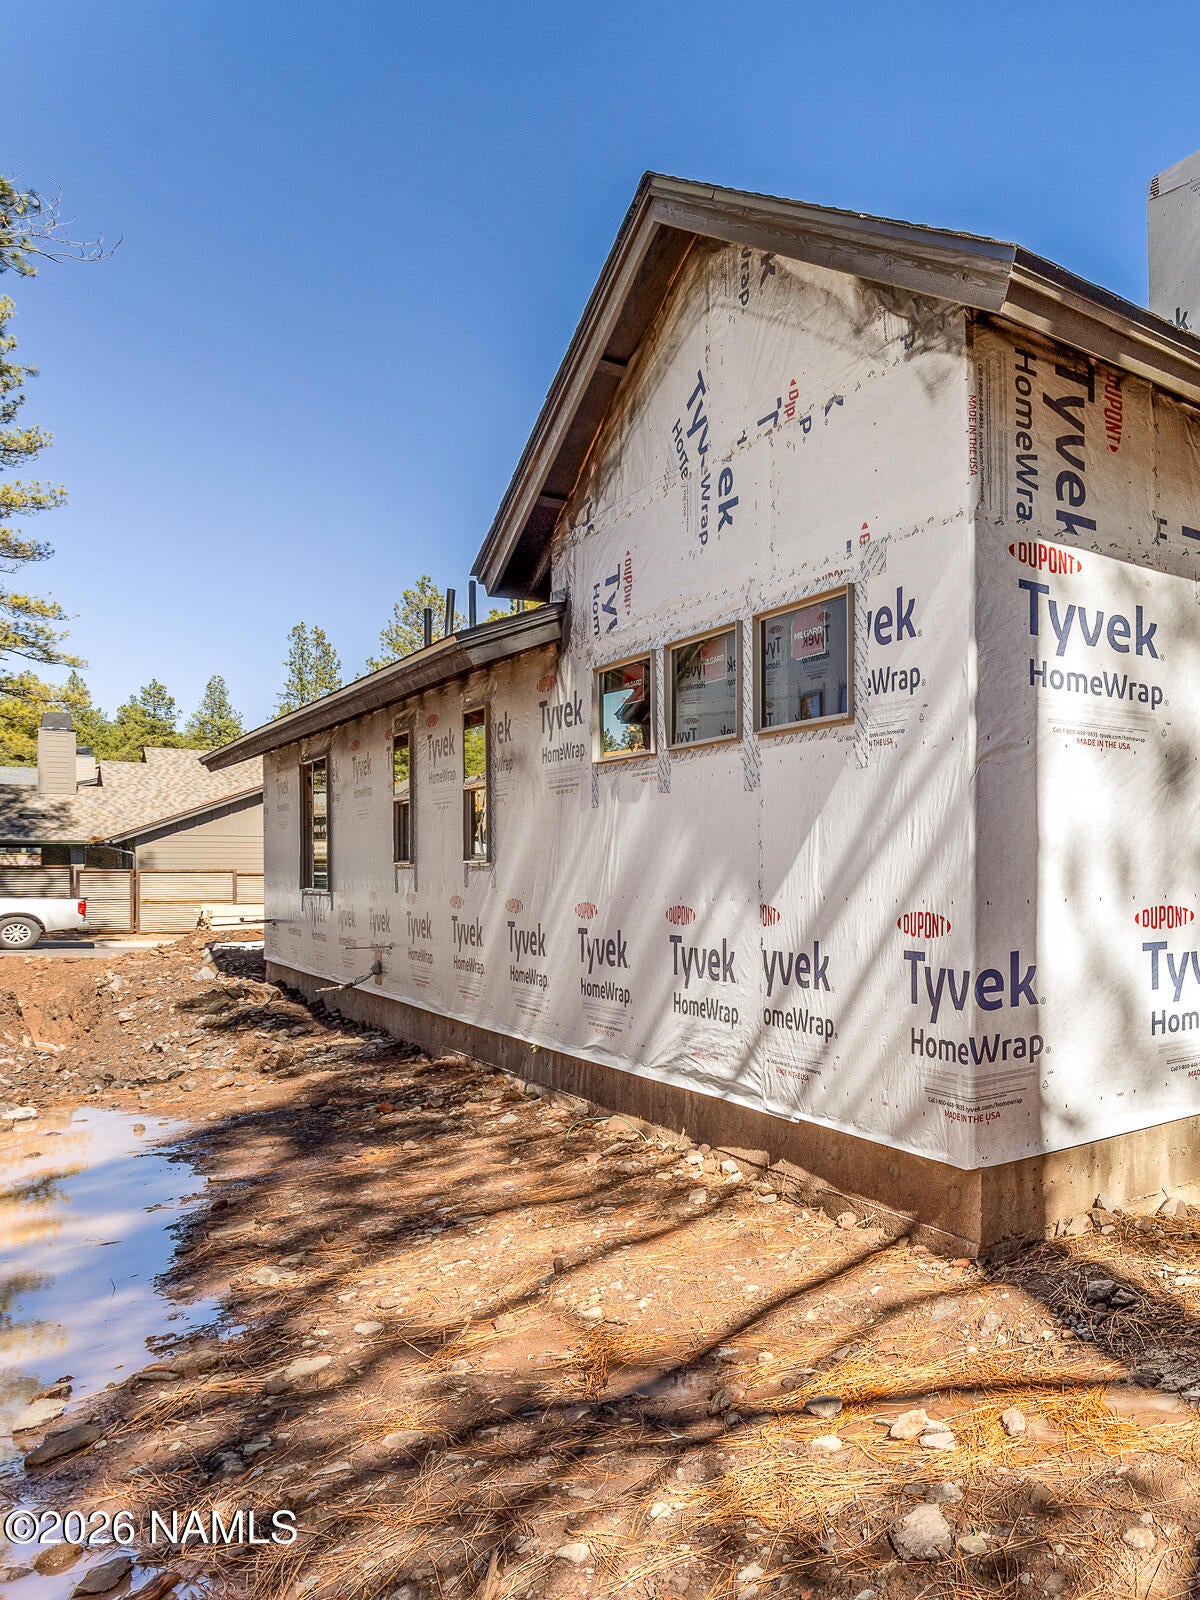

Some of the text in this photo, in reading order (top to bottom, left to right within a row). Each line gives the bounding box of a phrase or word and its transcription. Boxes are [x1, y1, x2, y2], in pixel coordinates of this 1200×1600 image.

[968, 395, 977, 423] MADE
[1104, 371, 1123, 445] DUPONT
[969, 425, 977, 436] IN
[969, 437, 977, 459] THE
[1042, 362, 1097, 536] Tyvek
[1018, 541, 1075, 575] DUPONT
[623, 557, 633, 609] DUPONT
[793, 626, 822, 640] MILGARD
[1018, 578, 1159, 660] Tyvek
[1028, 658, 1164, 711] HomeWrap
[539, 690, 584, 741] Tyvek
[427, 728, 455, 767] Tyvek
[542, 742, 585, 764] HomeWrap
[873, 738, 893, 748] THE USA
[1077, 738, 1131, 750] MADE IN THE USA
[1099, 732, 1146, 743] tyvek.com/homewrap
[406, 910, 432, 944] Tyvek
[668, 905, 693, 926] DUPONT
[903, 911, 946, 939] DUPONT
[1142, 905, 1189, 929] DUPONT
[451, 915, 483, 952] Tyvek
[507, 921, 546, 962] Tyvek
[453, 955, 485, 975] HomeWrap
[578, 927, 628, 974] Tyvek
[669, 935, 736, 989] Tyvek
[509, 965, 548, 991] HomeWrap
[580, 978, 630, 1004] HomeWrap
[903, 950, 1039, 1024] Tyvek
[673, 992, 739, 1030] HomeWrap
[911, 1027, 1045, 1066] HomeWrap
[944, 1109, 1001, 1124] MADE IN THE USA
[965, 1098, 1023, 1113] tyvek.com/homewrap
